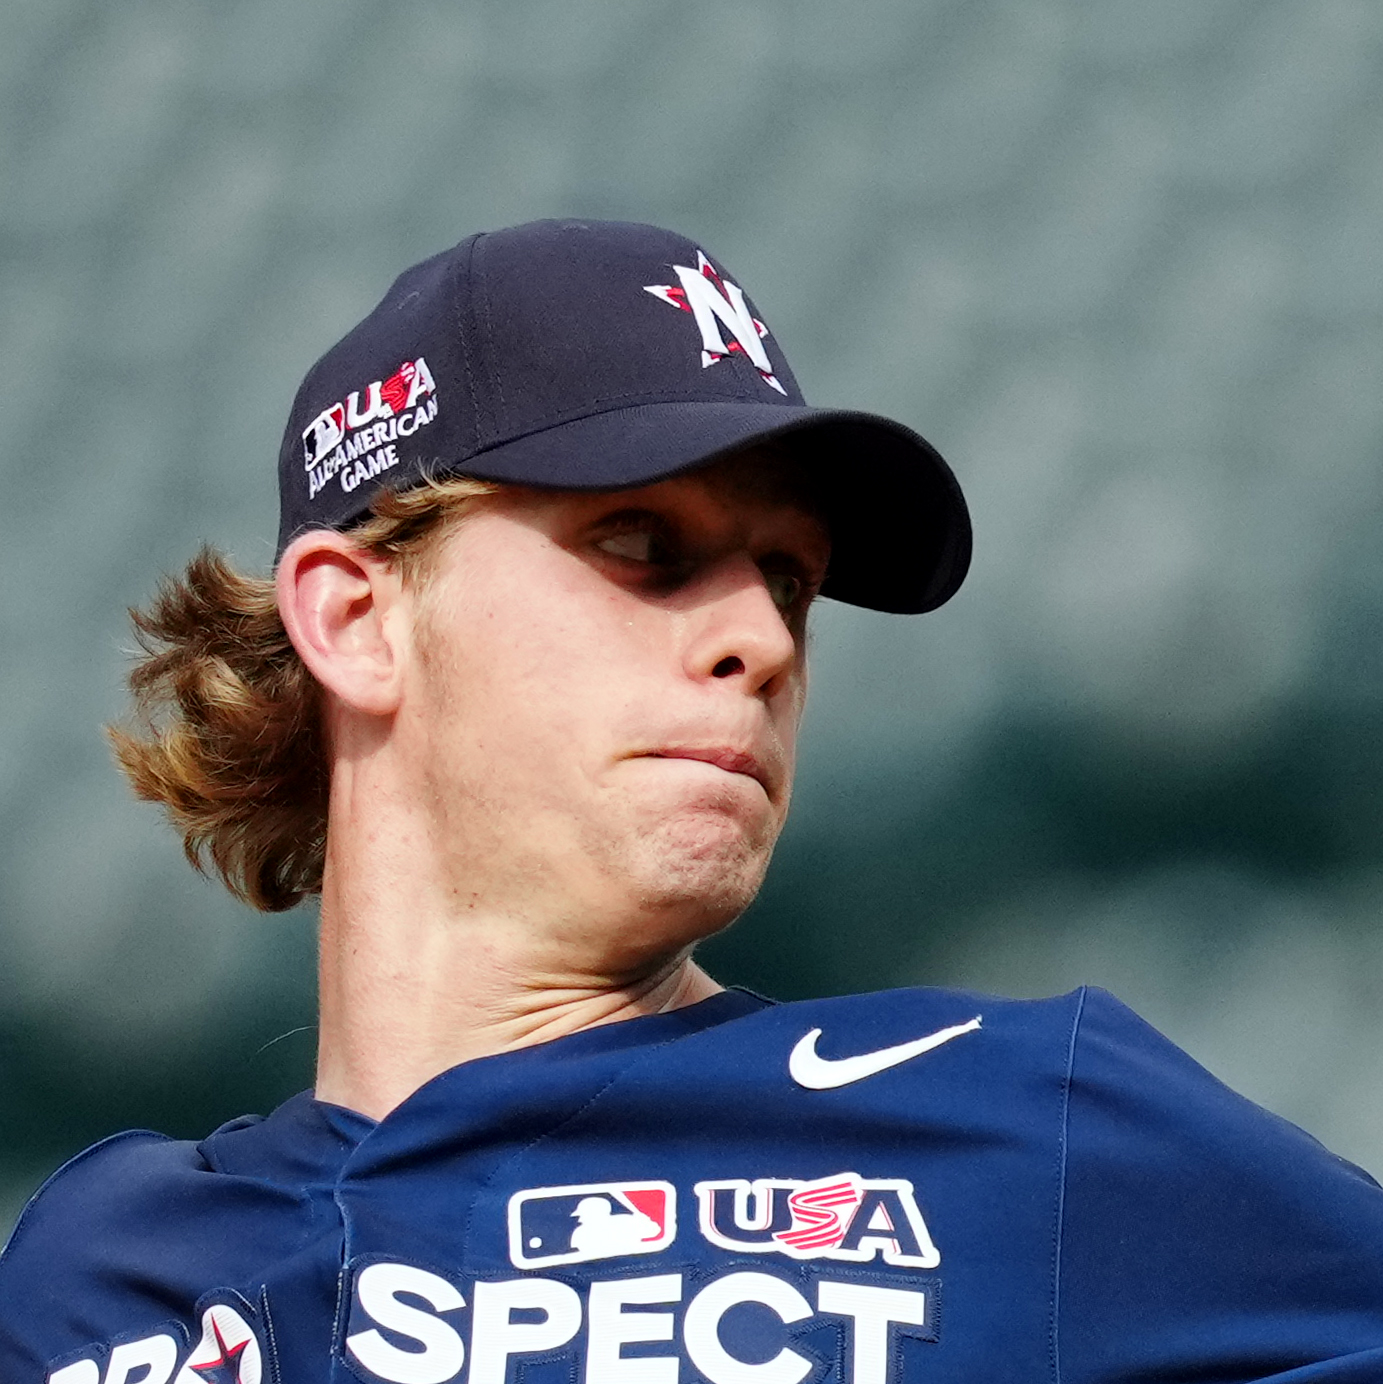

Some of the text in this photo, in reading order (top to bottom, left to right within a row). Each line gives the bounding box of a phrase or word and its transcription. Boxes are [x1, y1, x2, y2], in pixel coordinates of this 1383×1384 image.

[672, 264, 774, 374] N
[346, 357, 436, 430] USA
[340, 444, 400, 492] GAME
[699, 1174, 937, 1265] USA
